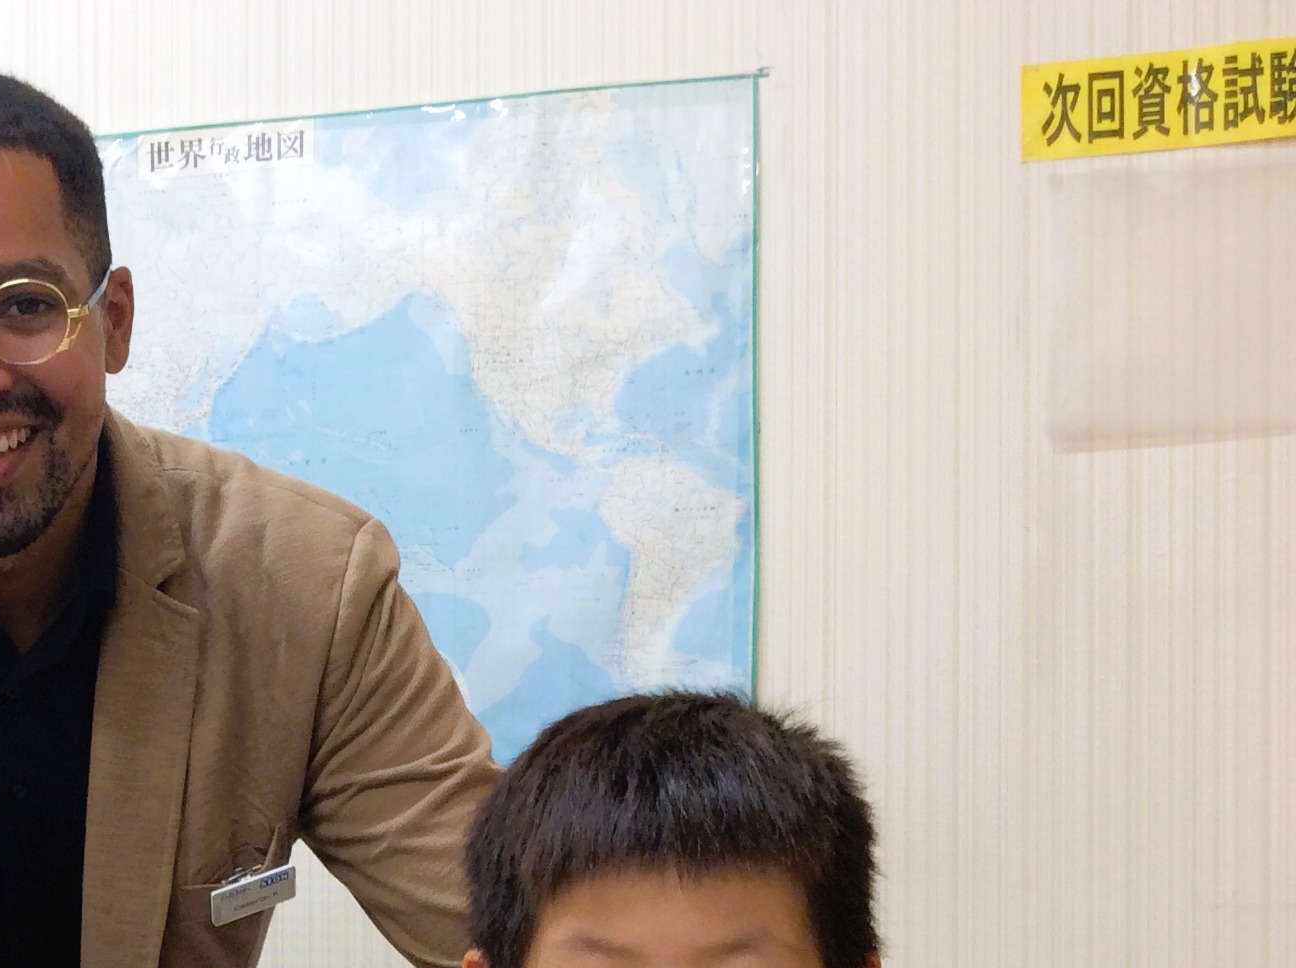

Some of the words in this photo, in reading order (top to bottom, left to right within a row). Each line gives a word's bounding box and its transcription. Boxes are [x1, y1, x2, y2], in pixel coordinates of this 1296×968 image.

[146, 130, 304, 173] 世界行政地図
